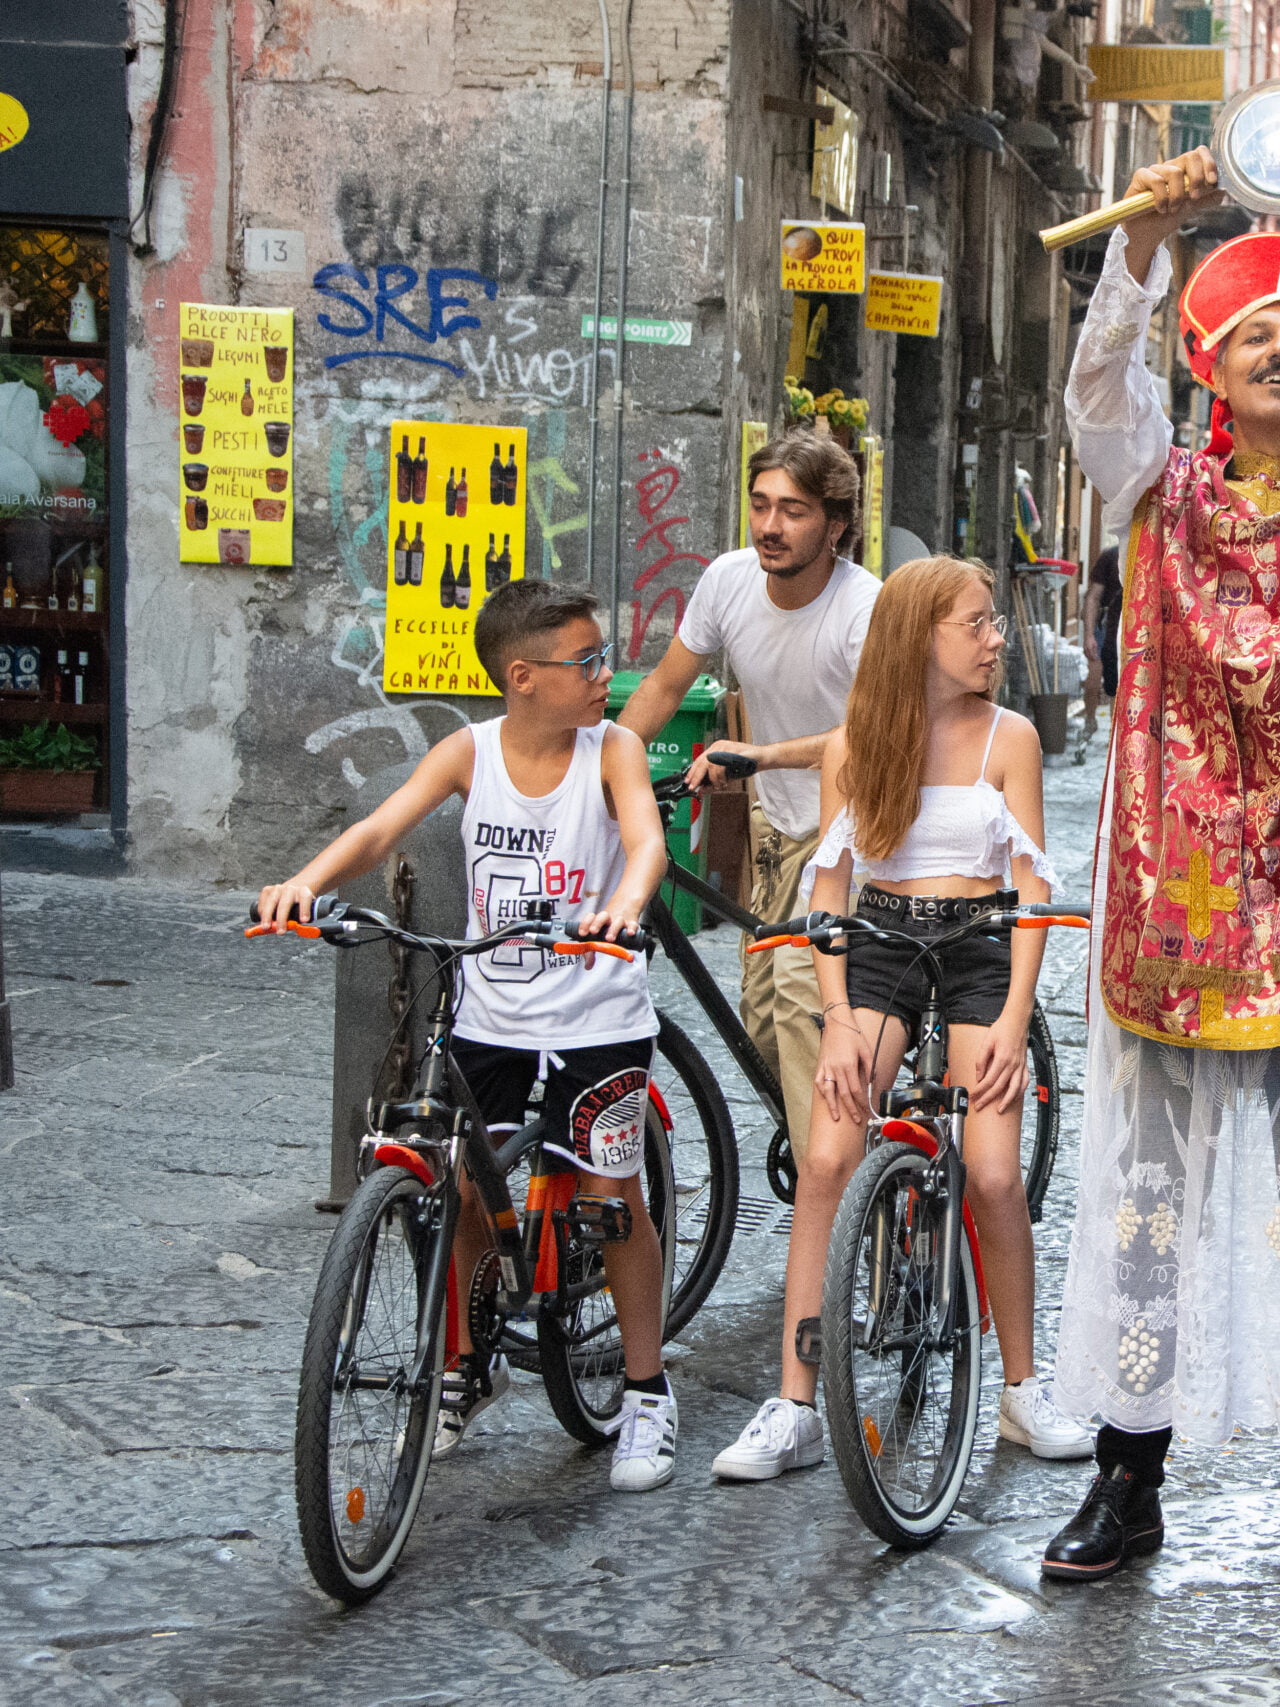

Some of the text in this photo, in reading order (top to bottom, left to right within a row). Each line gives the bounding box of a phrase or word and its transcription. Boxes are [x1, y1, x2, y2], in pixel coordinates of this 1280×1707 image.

[826, 231, 854, 245] QUI
[261, 240, 287, 262] 13
[823, 248, 860, 262] TROVI
[801, 260, 853, 275] PROVOLA
[786, 278, 857, 291] AGEROLA
[188, 307, 269, 327] PRODOTTI
[866, 311, 930, 329] CAMPANIA
[188, 323, 282, 342] ALCE NERO
[218, 349, 259, 366] LEGUMI
[207, 388, 238, 406] SUGHI
[257, 386, 288, 397] ACETO
[258, 401, 288, 414] MELE
[213, 430, 258, 451] PESTI
[214, 483, 253, 499] MIELI
[25, 494, 97, 509] Aversana
[210, 506, 252, 522] SUCCHI
[395, 618, 470, 635] ECCELLE
[418, 650, 461, 670] VINI
[390, 672, 489, 690] CAMPANI
[648, 742, 679, 754] TRO
[474, 822, 546, 853] DOWN
[545, 860, 586, 904] 87
[498, 898, 560, 918] HIGT
[574, 1093, 603, 1155] URBAN
